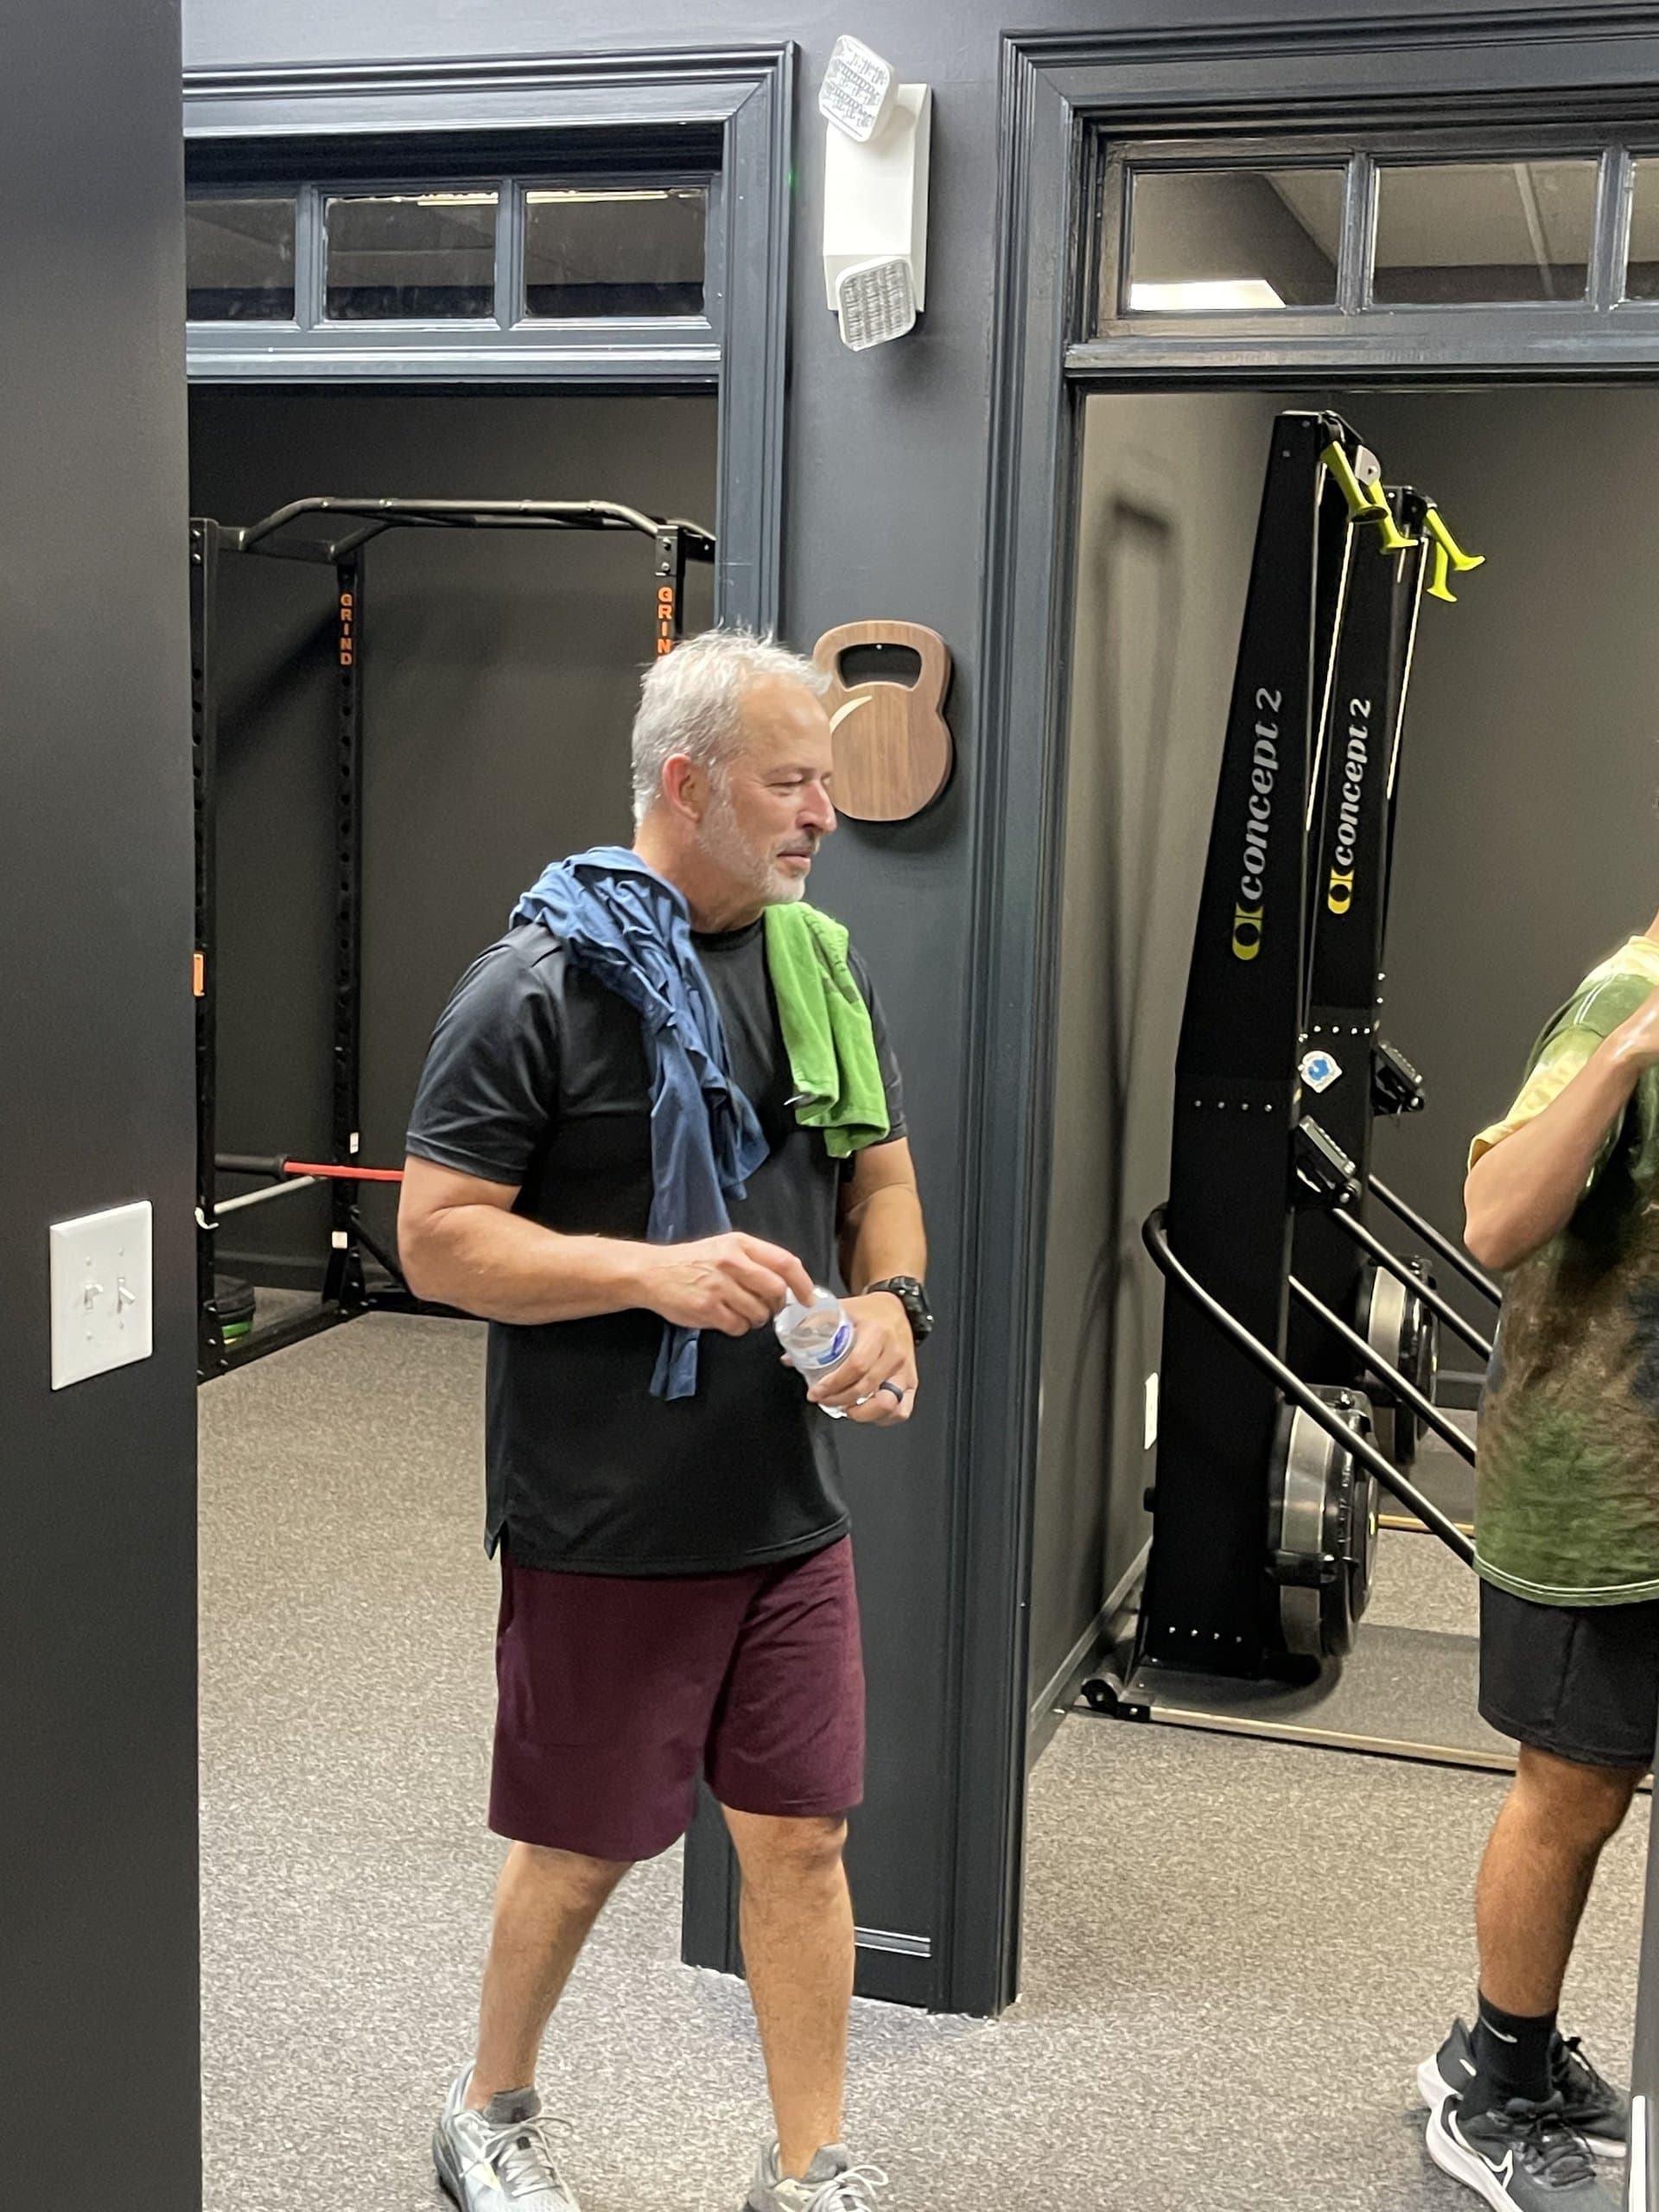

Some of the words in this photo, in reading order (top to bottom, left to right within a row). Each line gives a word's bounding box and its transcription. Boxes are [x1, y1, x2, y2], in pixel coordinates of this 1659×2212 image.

[340, 594, 353, 665] GRIND
[658, 587, 672, 662] GRIN
[1255, 687, 1282, 713] 2
[1350, 698, 1371, 719] 2
[1241, 721, 1279, 900] concept
[1335, 724, 1369, 867] concept
